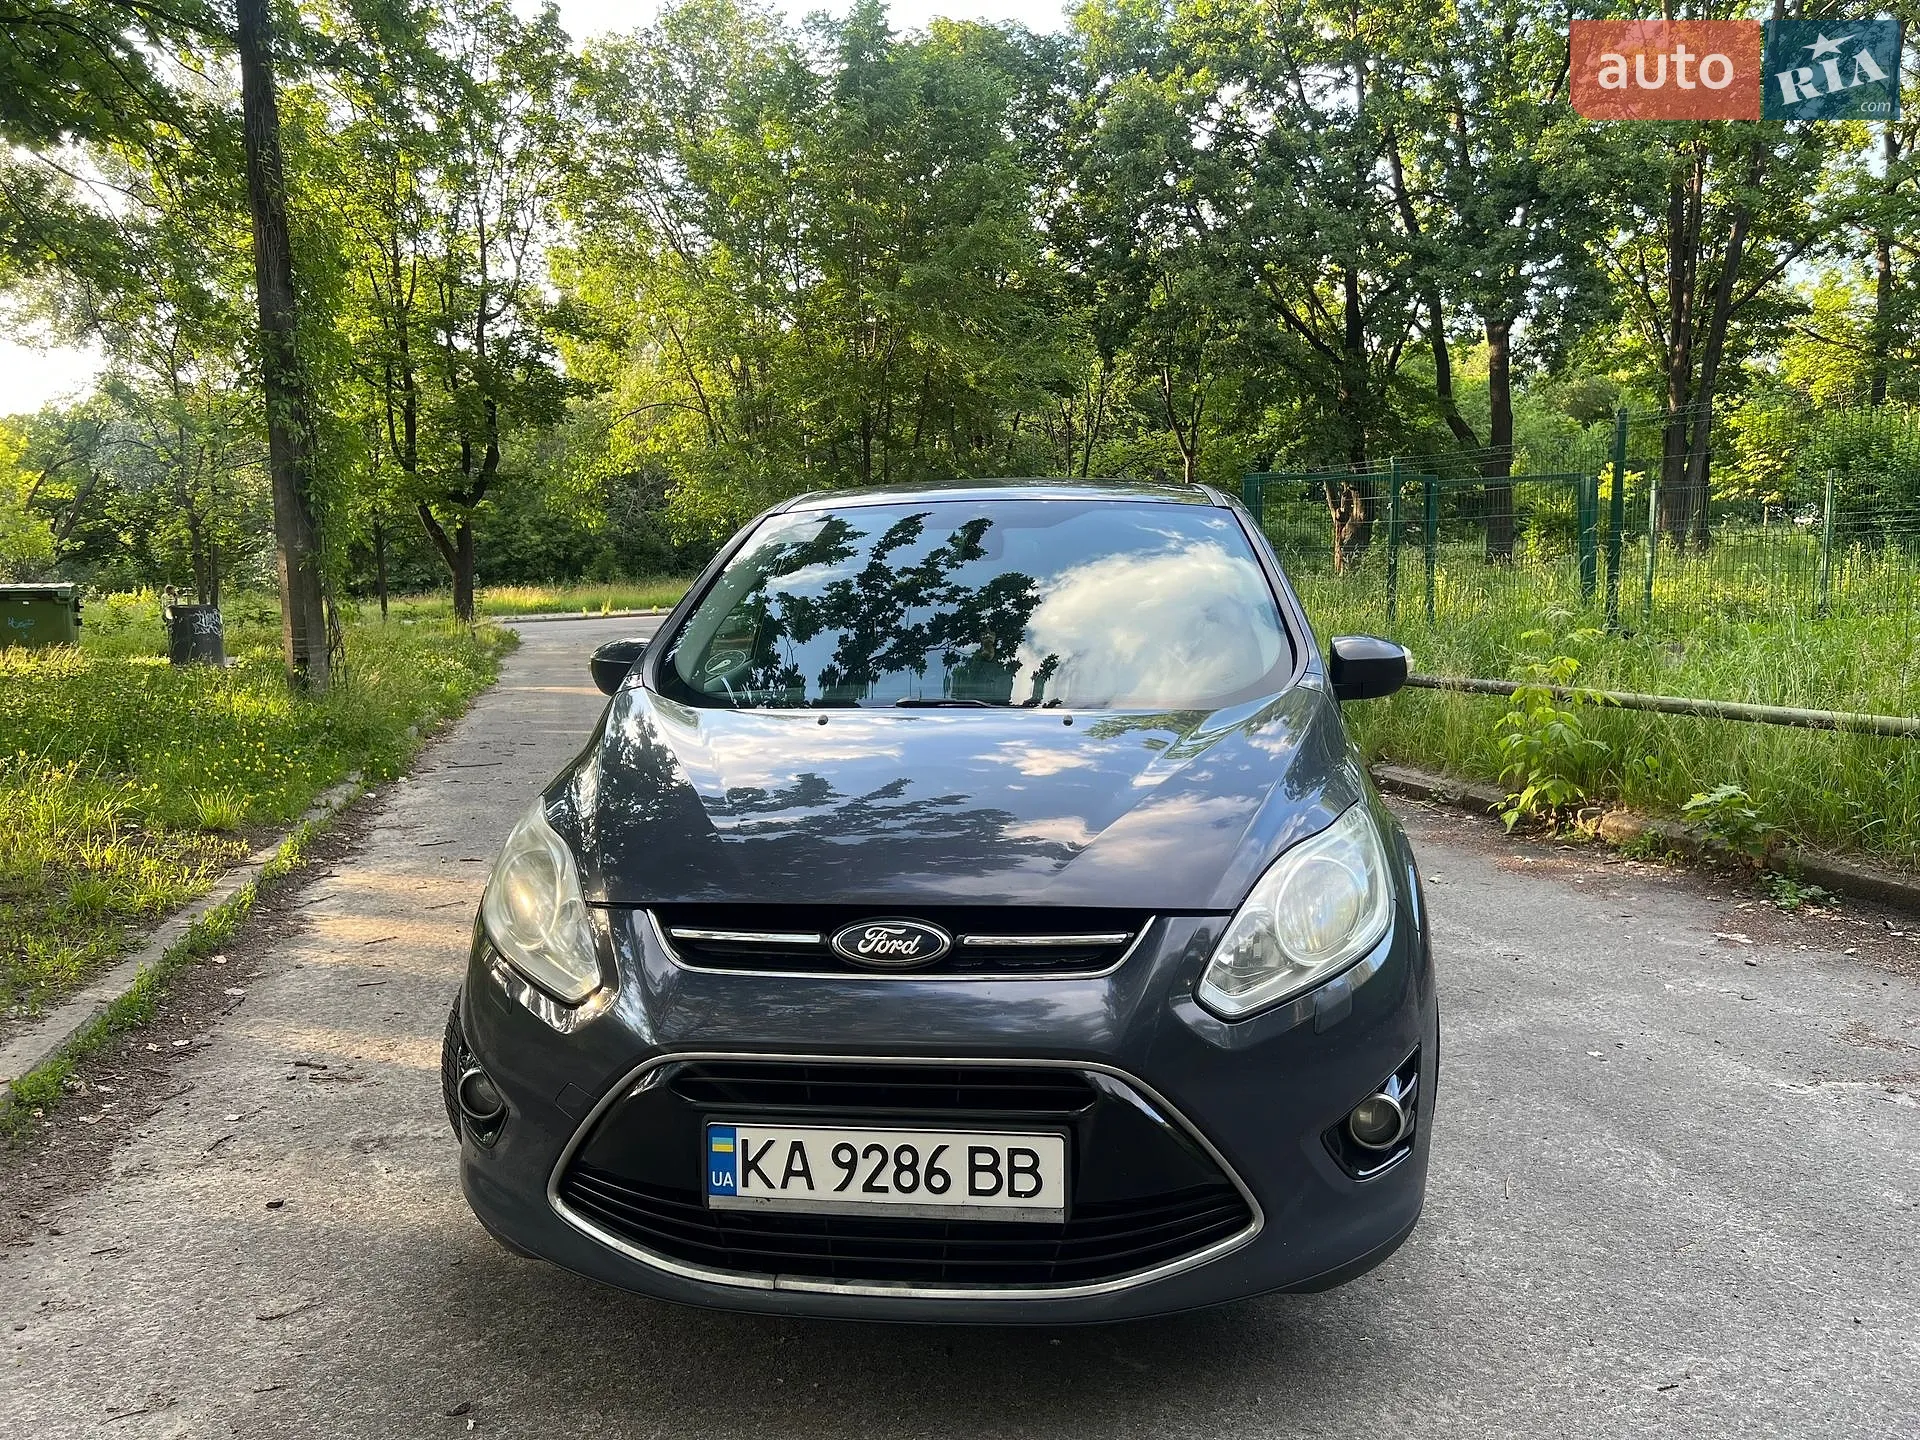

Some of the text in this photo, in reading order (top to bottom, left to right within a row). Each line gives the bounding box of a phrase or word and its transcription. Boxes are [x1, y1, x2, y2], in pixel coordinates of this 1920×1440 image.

[857, 927, 922, 955] Ford
[711, 1171, 734, 1188] UA
[740, 1138, 1043, 1198] KA 9286 BB
